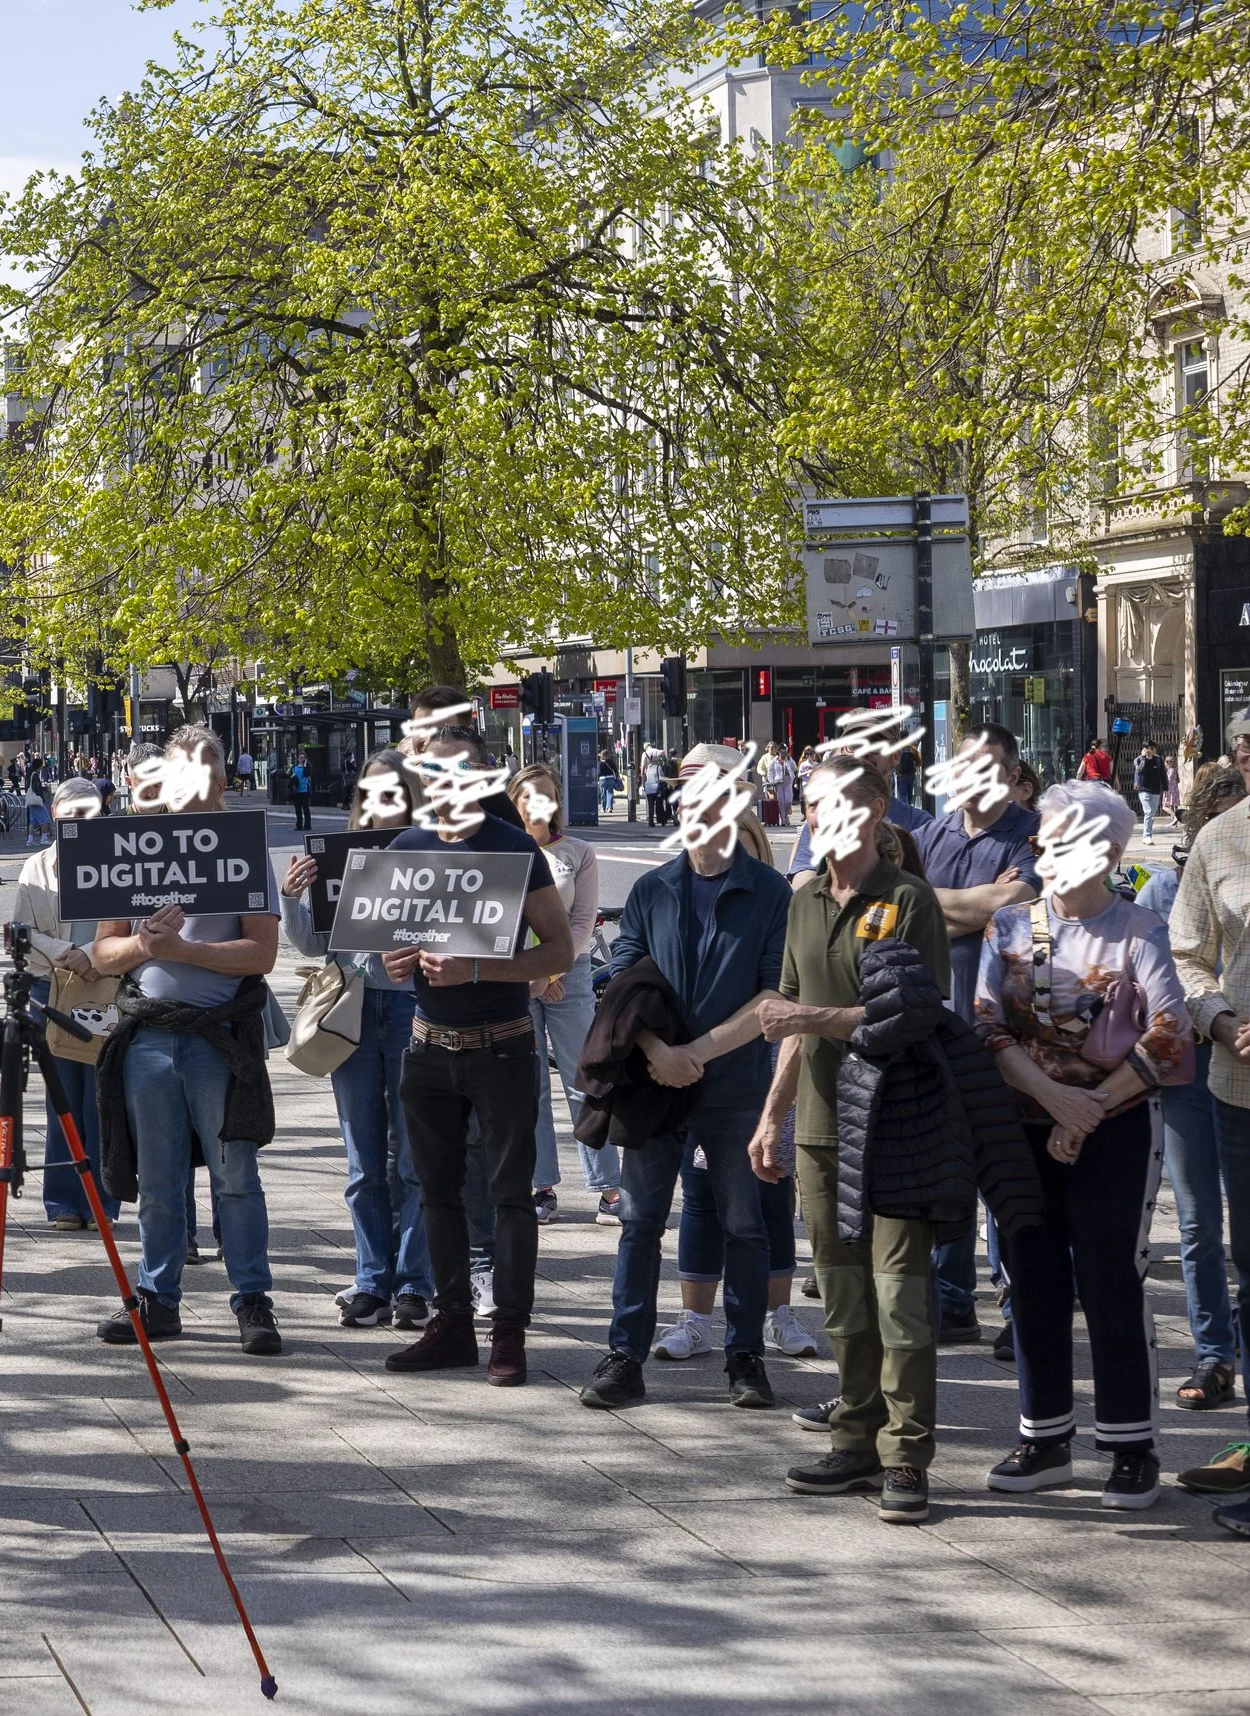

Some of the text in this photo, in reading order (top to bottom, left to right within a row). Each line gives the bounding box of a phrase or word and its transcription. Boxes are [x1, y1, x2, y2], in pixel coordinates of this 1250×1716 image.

[979, 634, 1001, 646] HOTEL
[968, 647, 1029, 673] hocolat.
[852, 686, 871, 695] CAFÉ
[114, 828, 219, 857] NO TO
[76, 858, 250, 890] DIGITAL ID
[390, 867, 484, 893] NO TO
[131, 891, 197, 908] #together
[351, 896, 504, 925] DIGITAL ID
[393, 928, 451, 944] #together
